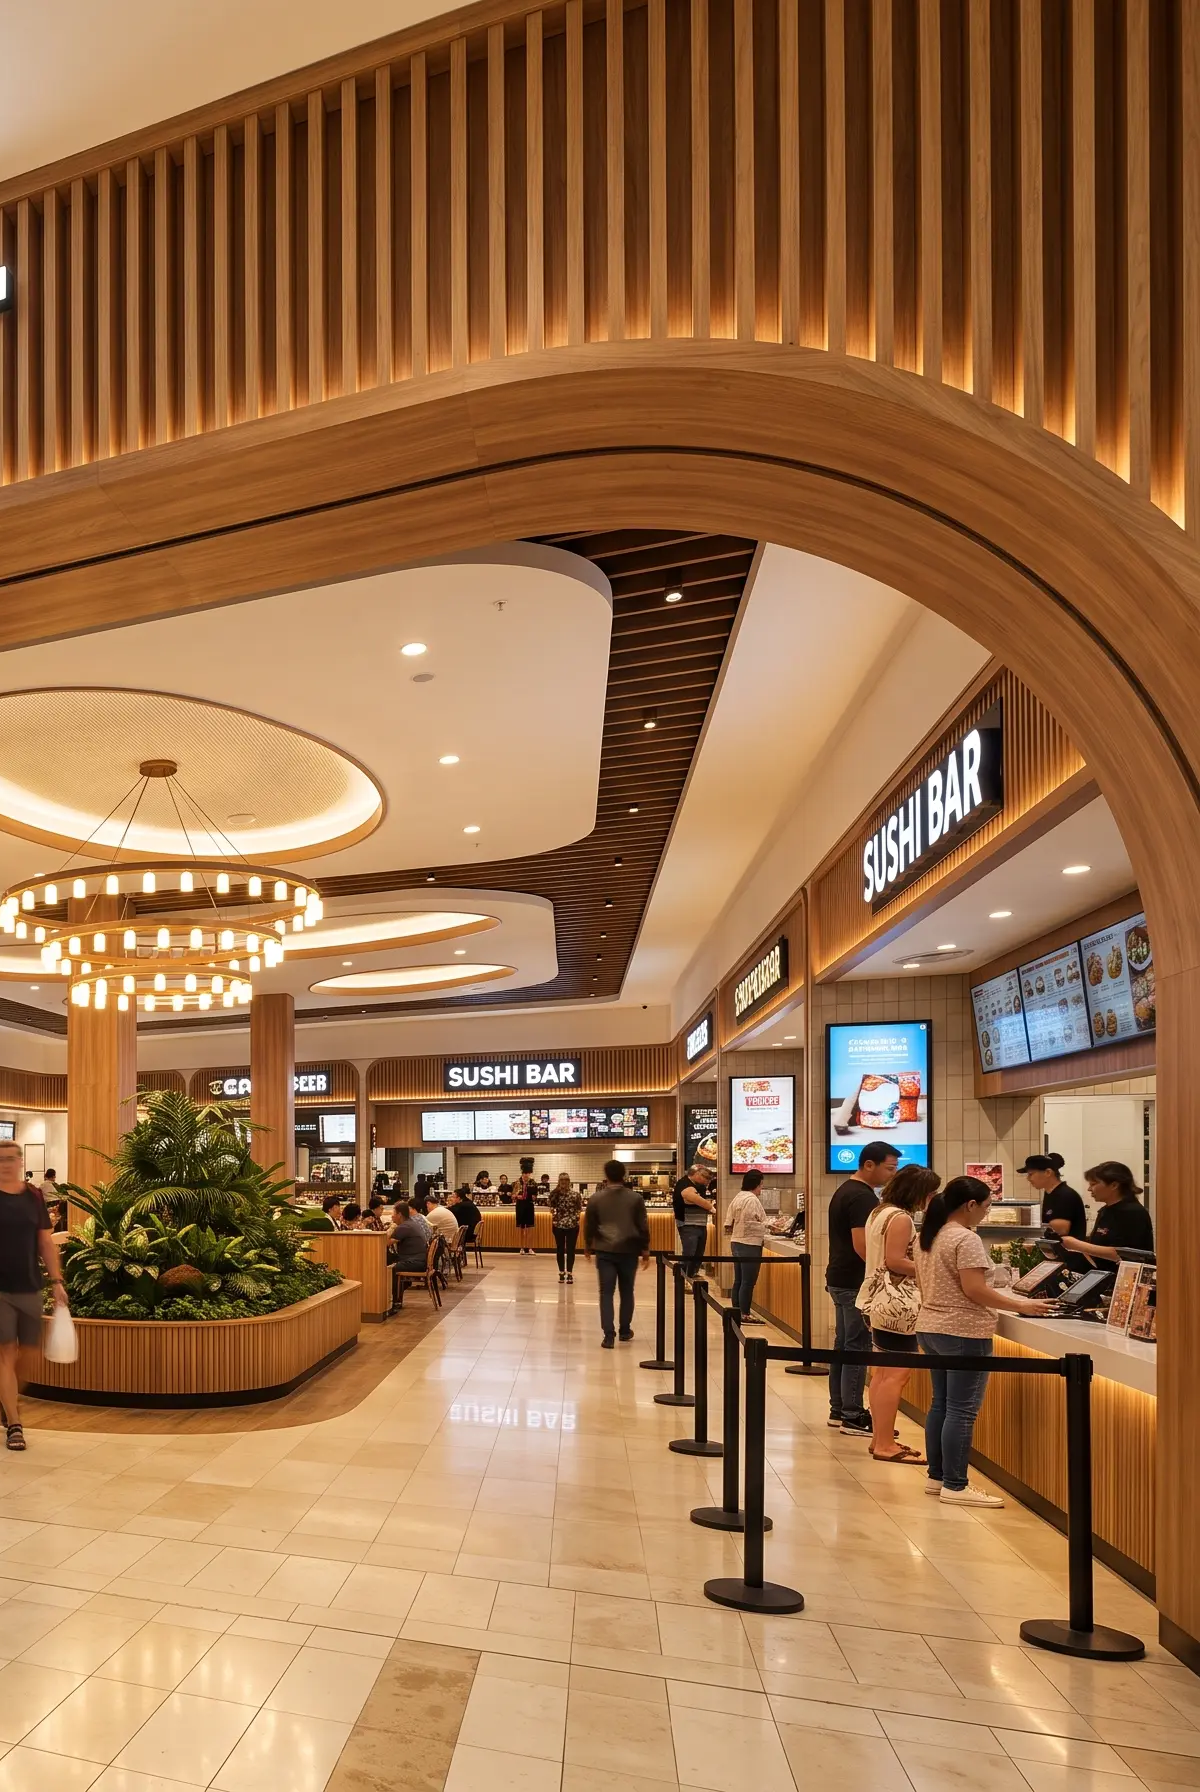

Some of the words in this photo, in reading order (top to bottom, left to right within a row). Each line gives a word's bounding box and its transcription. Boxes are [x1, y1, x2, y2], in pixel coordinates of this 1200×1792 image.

[863, 788, 922, 903] SUSHI
[927, 728, 983, 846] BAR
[448, 1065, 519, 1087] SUSHI
[526, 1062, 575, 1084] BAR
